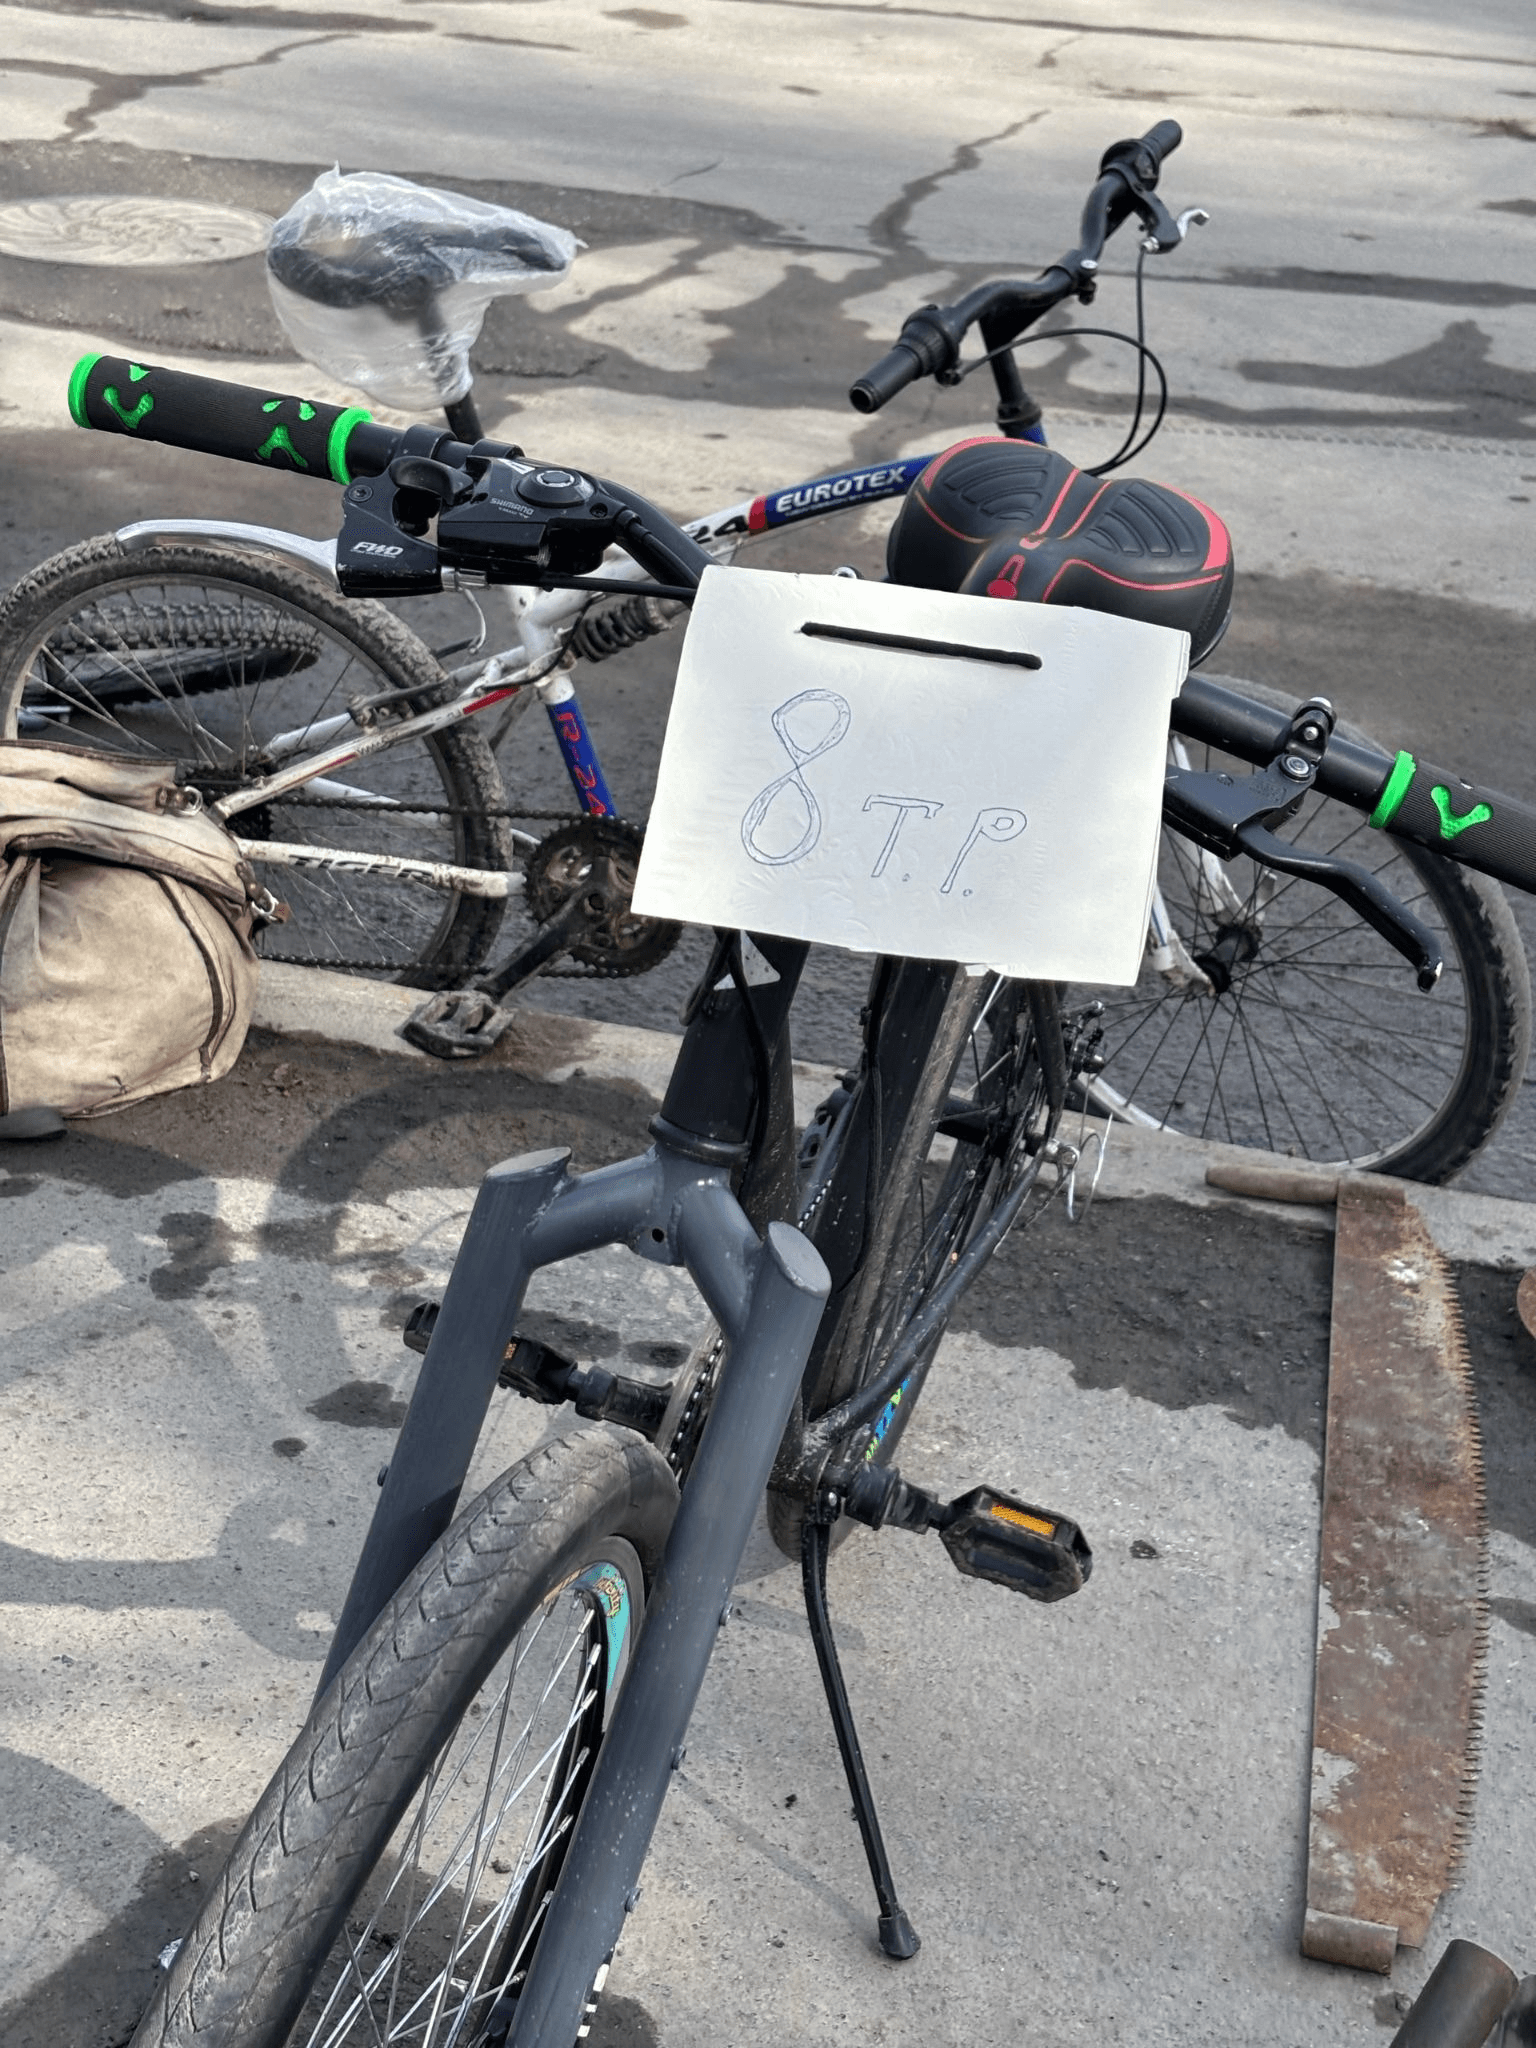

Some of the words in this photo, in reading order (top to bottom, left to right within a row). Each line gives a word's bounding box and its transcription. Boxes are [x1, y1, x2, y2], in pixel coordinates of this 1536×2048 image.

[490, 498, 535, 516] SHIMANO
[776, 466, 907, 513] EUROTEX
[741, 688, 852, 866] 8
[288, 854, 434, 885] TIGER
